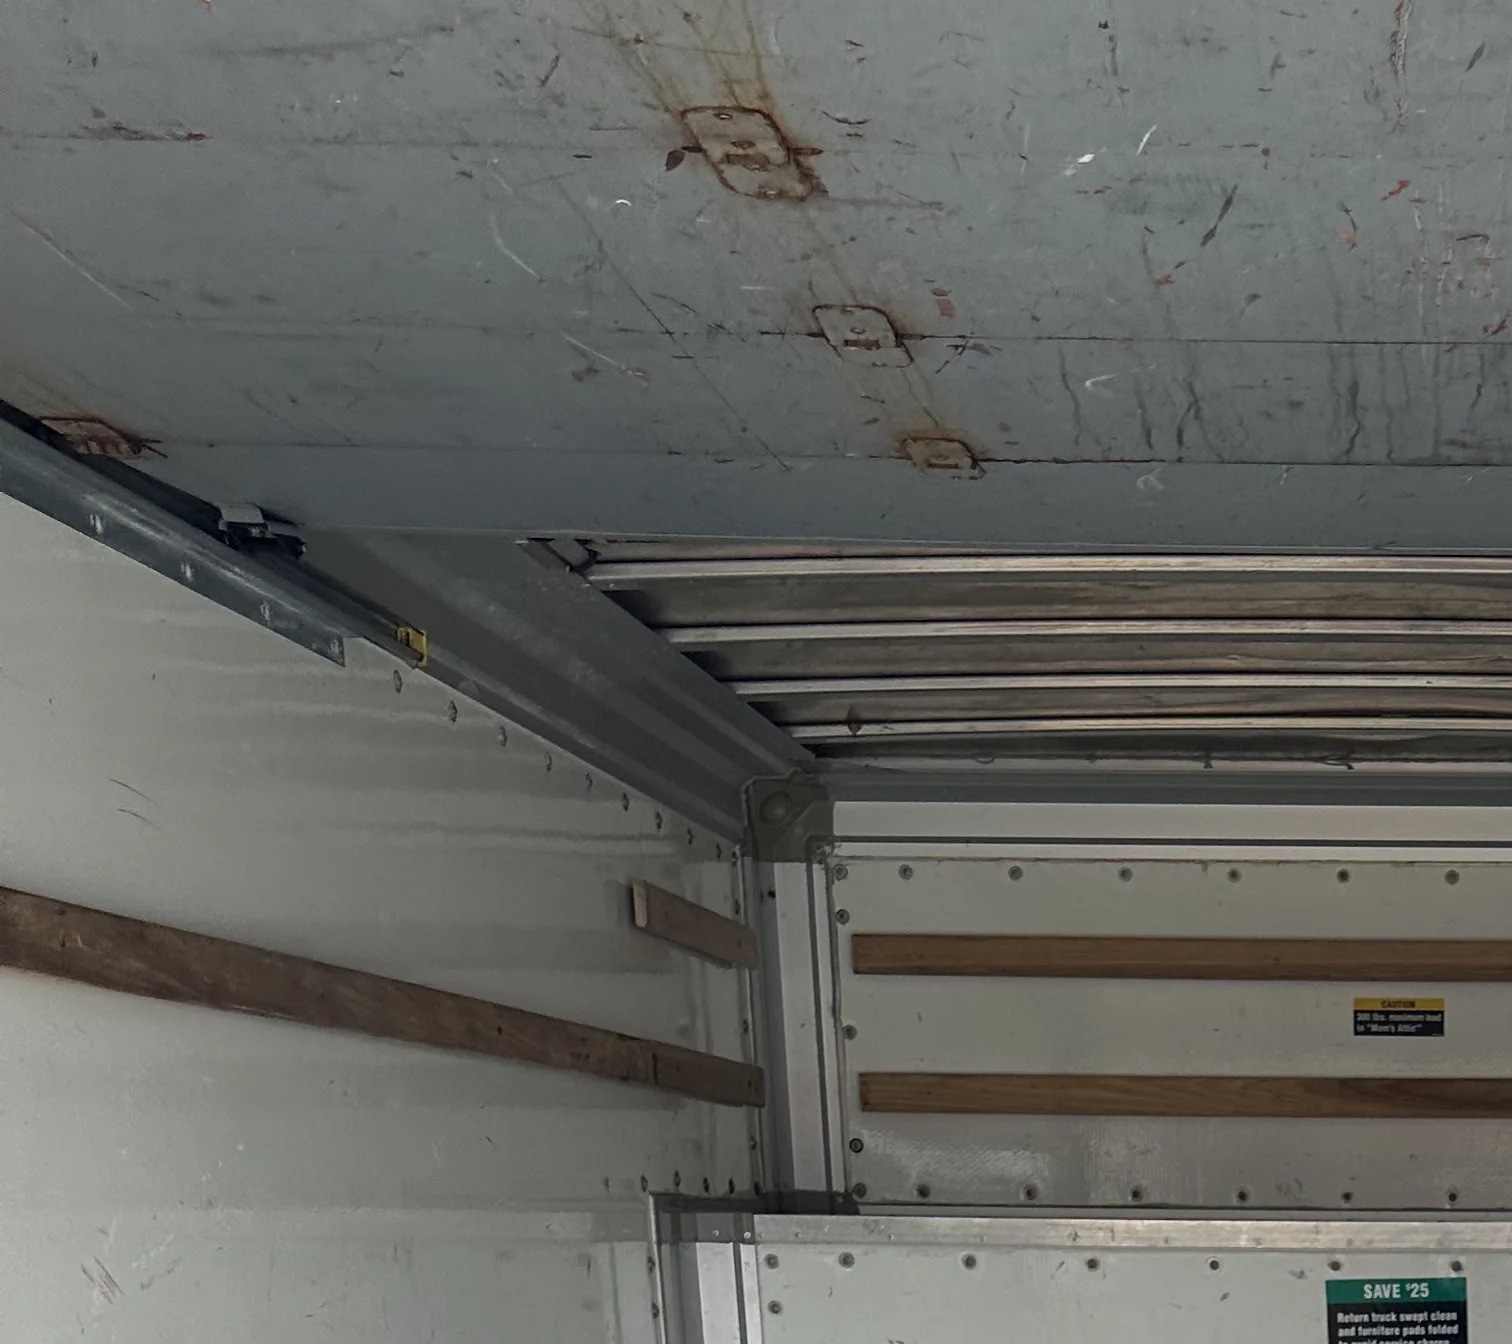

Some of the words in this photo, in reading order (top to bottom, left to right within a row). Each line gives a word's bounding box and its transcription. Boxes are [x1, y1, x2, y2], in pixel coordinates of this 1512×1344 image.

[1364, 1283, 1400, 1299] SAVE
[1405, 1283, 1430, 1298] $25
[1336, 1312, 1369, 1323] Return
[1371, 1312, 1398, 1323] truck
[1399, 1311, 1428, 1323] swept
[1430, 1310, 1458, 1321] clean
[1337, 1326, 1356, 1337] and
[1357, 1325, 1401, 1336] furniture
[1402, 1325, 1426, 1337] pads
[1427, 1324, 1459, 1335] folded
